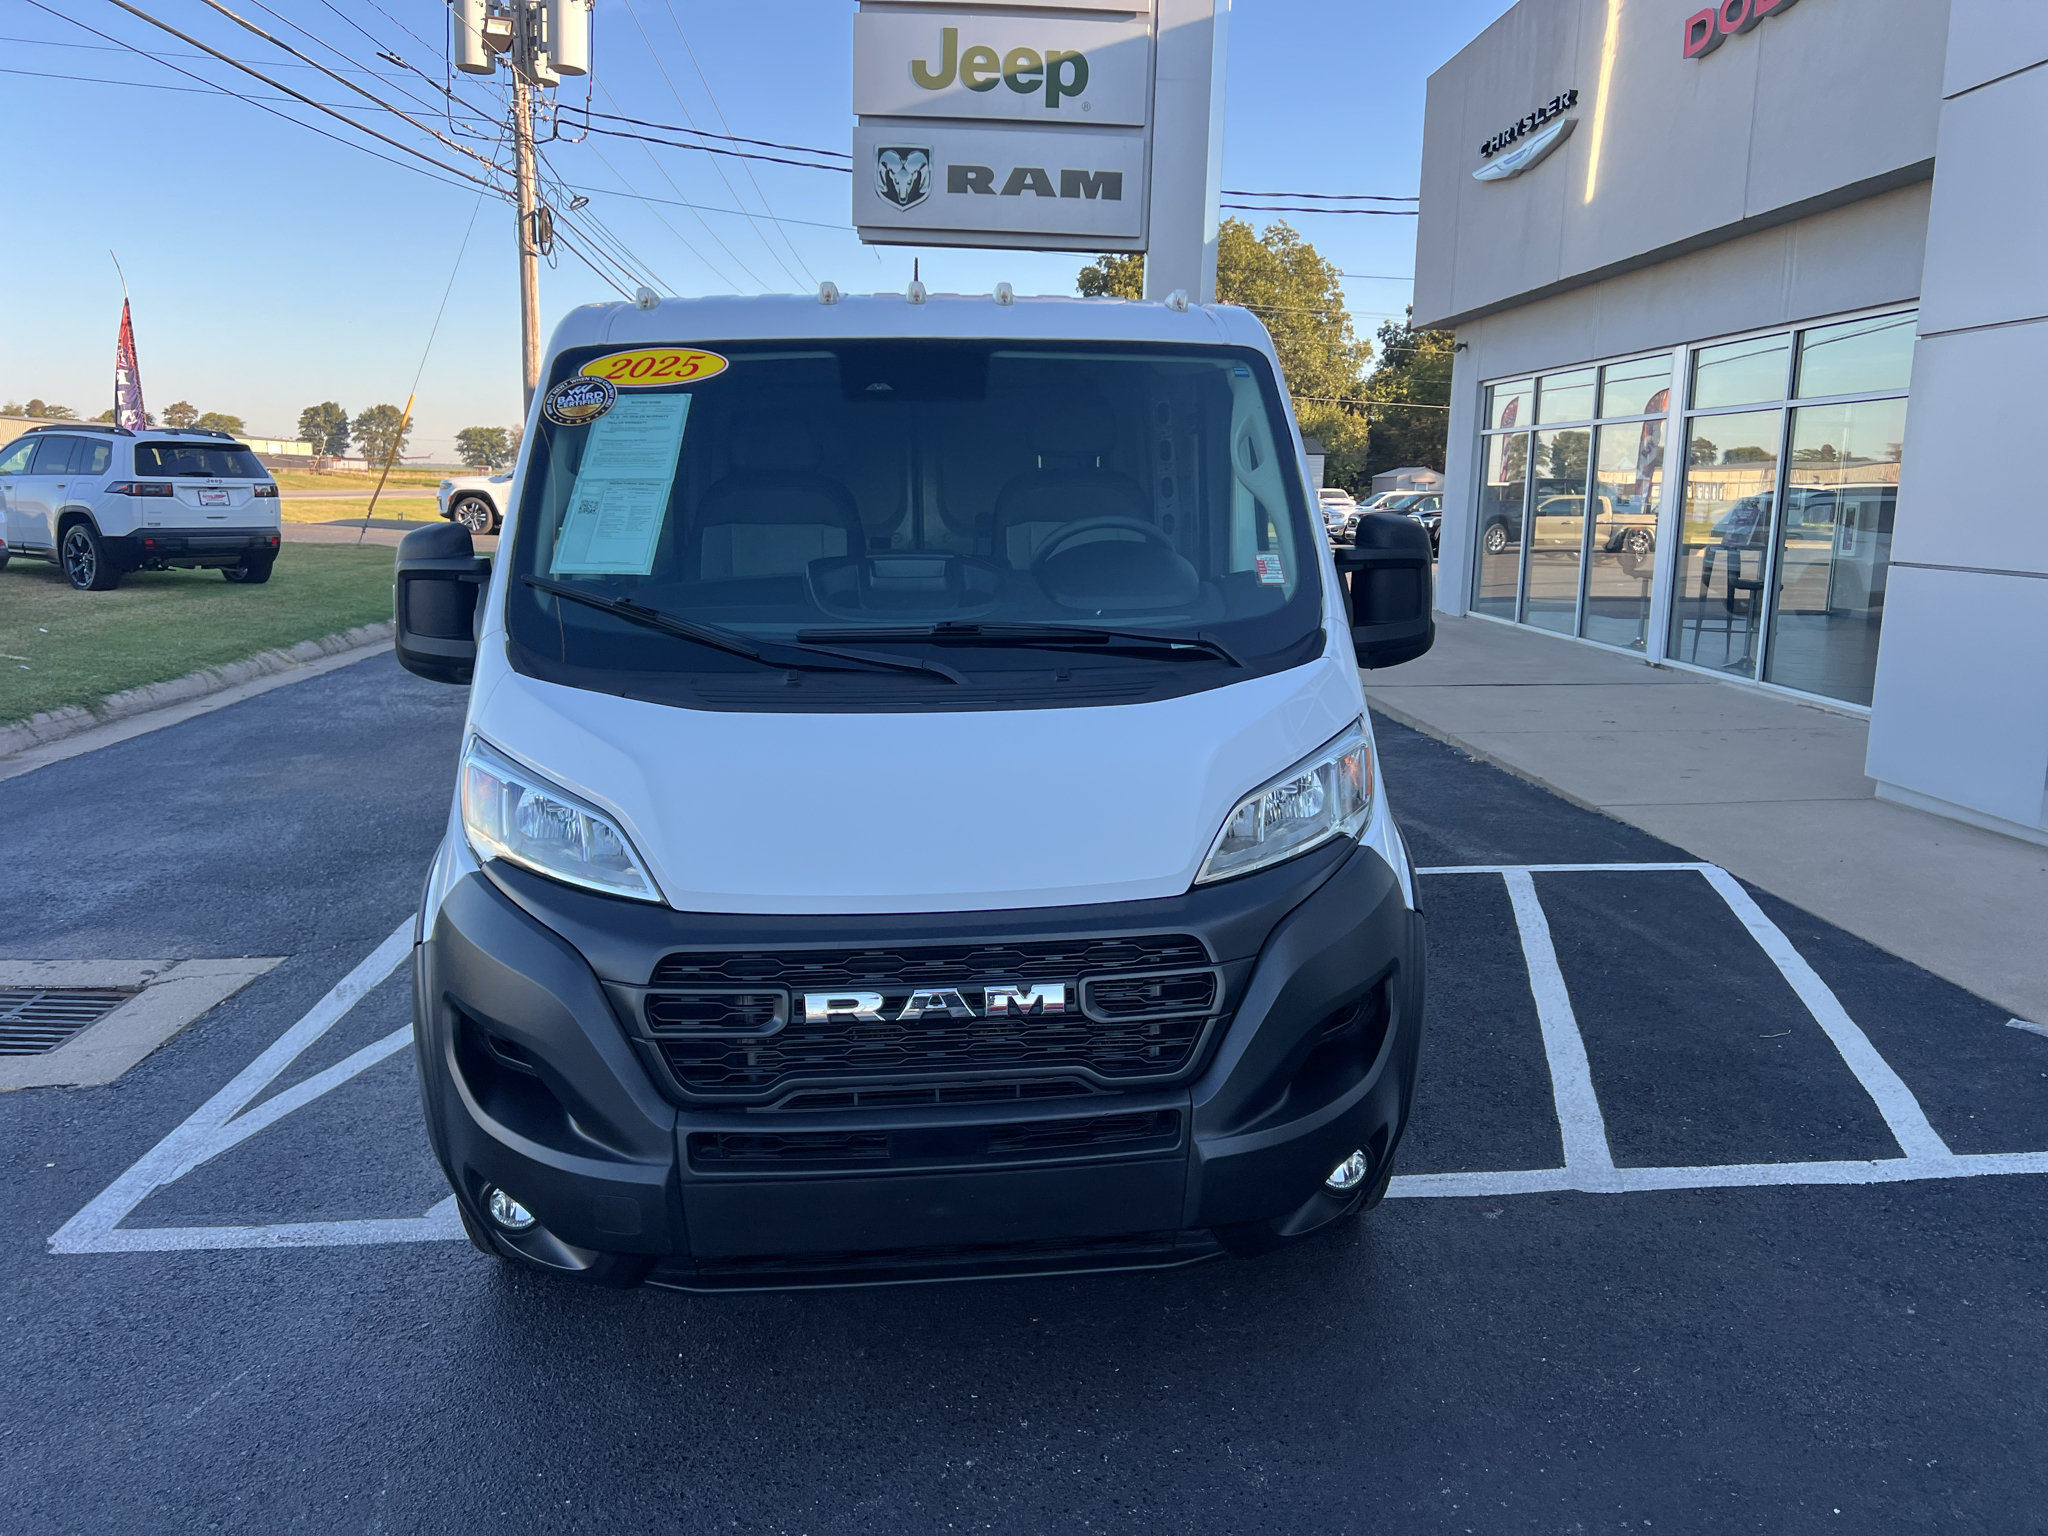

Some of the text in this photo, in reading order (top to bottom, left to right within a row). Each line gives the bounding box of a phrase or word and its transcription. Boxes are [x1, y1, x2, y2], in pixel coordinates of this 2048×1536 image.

[911, 27, 1089, 109] Jeep
[1480, 89, 1577, 158] CHRYSLER
[947, 164, 1123, 201] RAM
[570, 376, 590, 384] WHEN
[605, 355, 706, 380] 2025
[556, 397, 603, 409] CERTIFIED
[557, 391, 604, 403] BAYIRD
[803, 983, 1067, 1025] RAM
